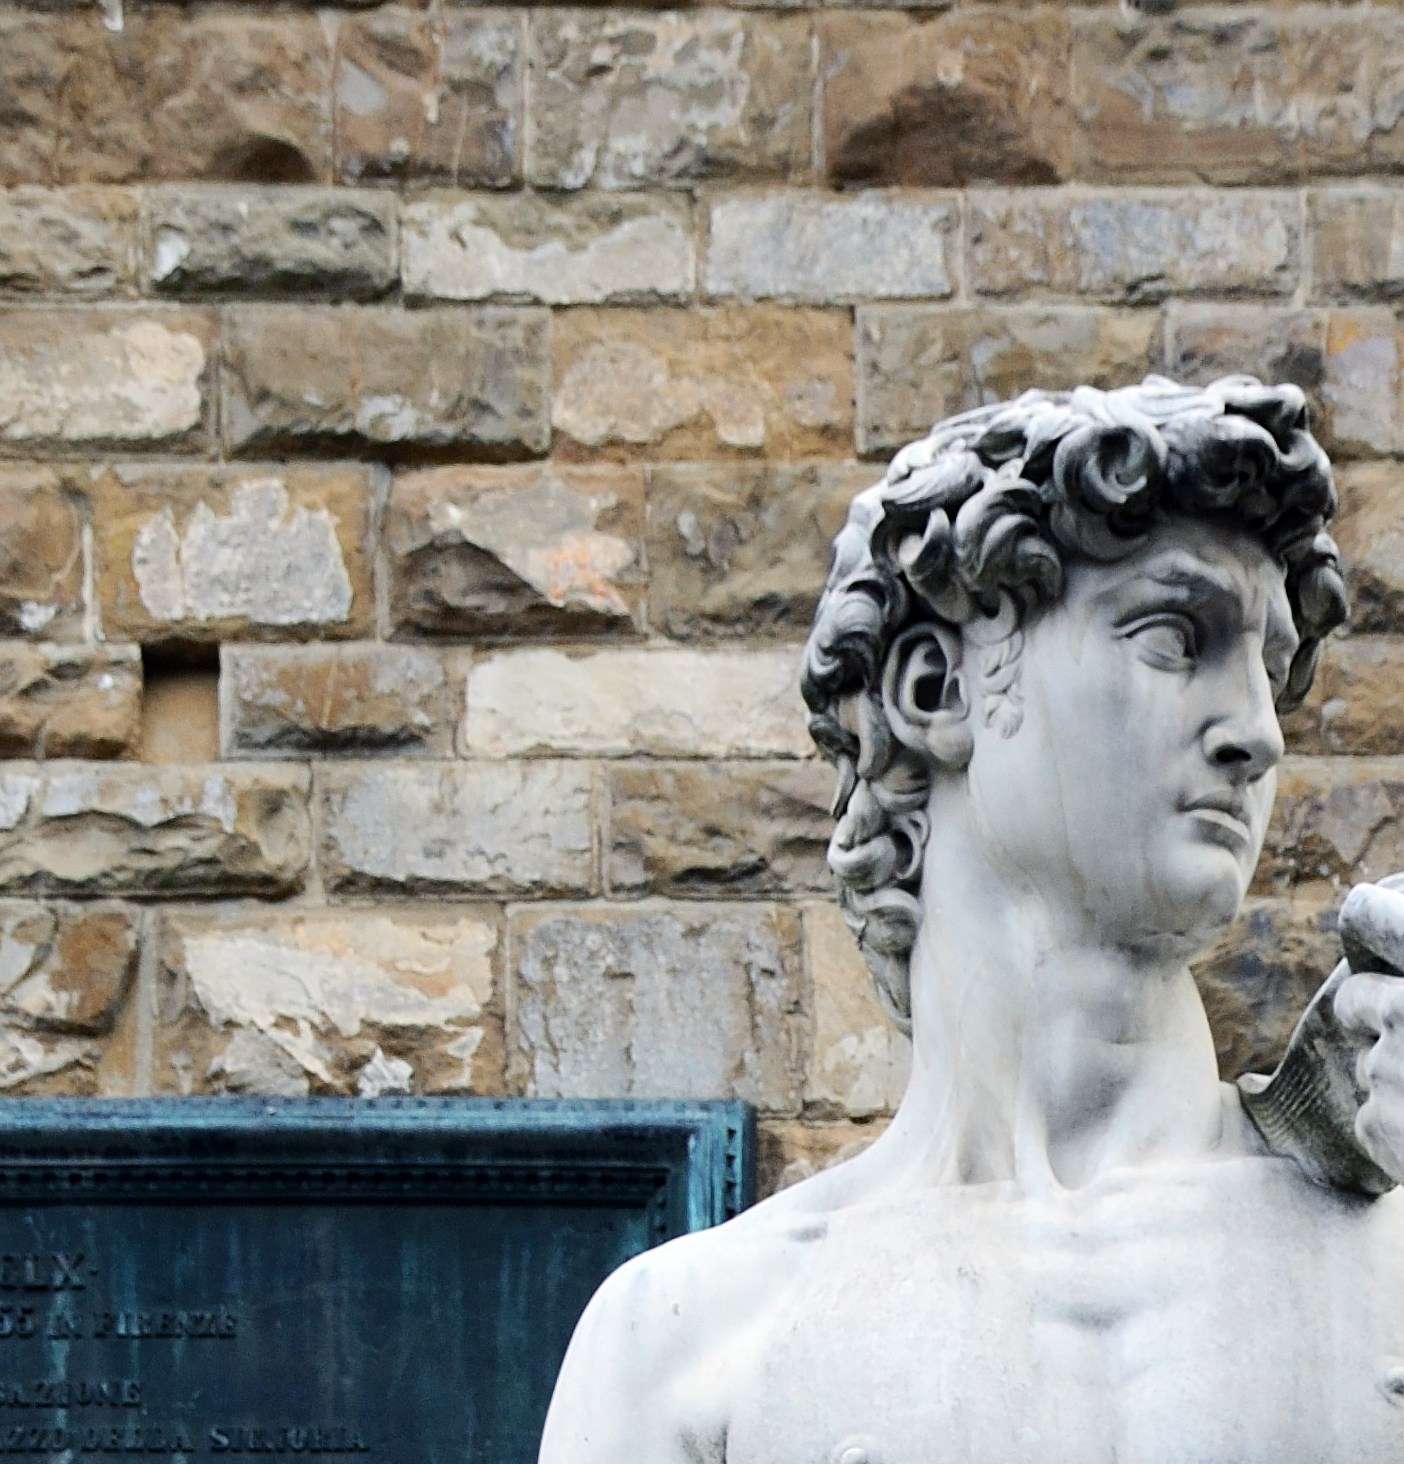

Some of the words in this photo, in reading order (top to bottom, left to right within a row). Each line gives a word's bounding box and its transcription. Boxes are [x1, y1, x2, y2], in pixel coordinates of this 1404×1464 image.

[0, 1379, 144, 1409] AZIONE
[0, 1426, 74, 1454] ZZO
[80, 1426, 197, 1454] DELLA
